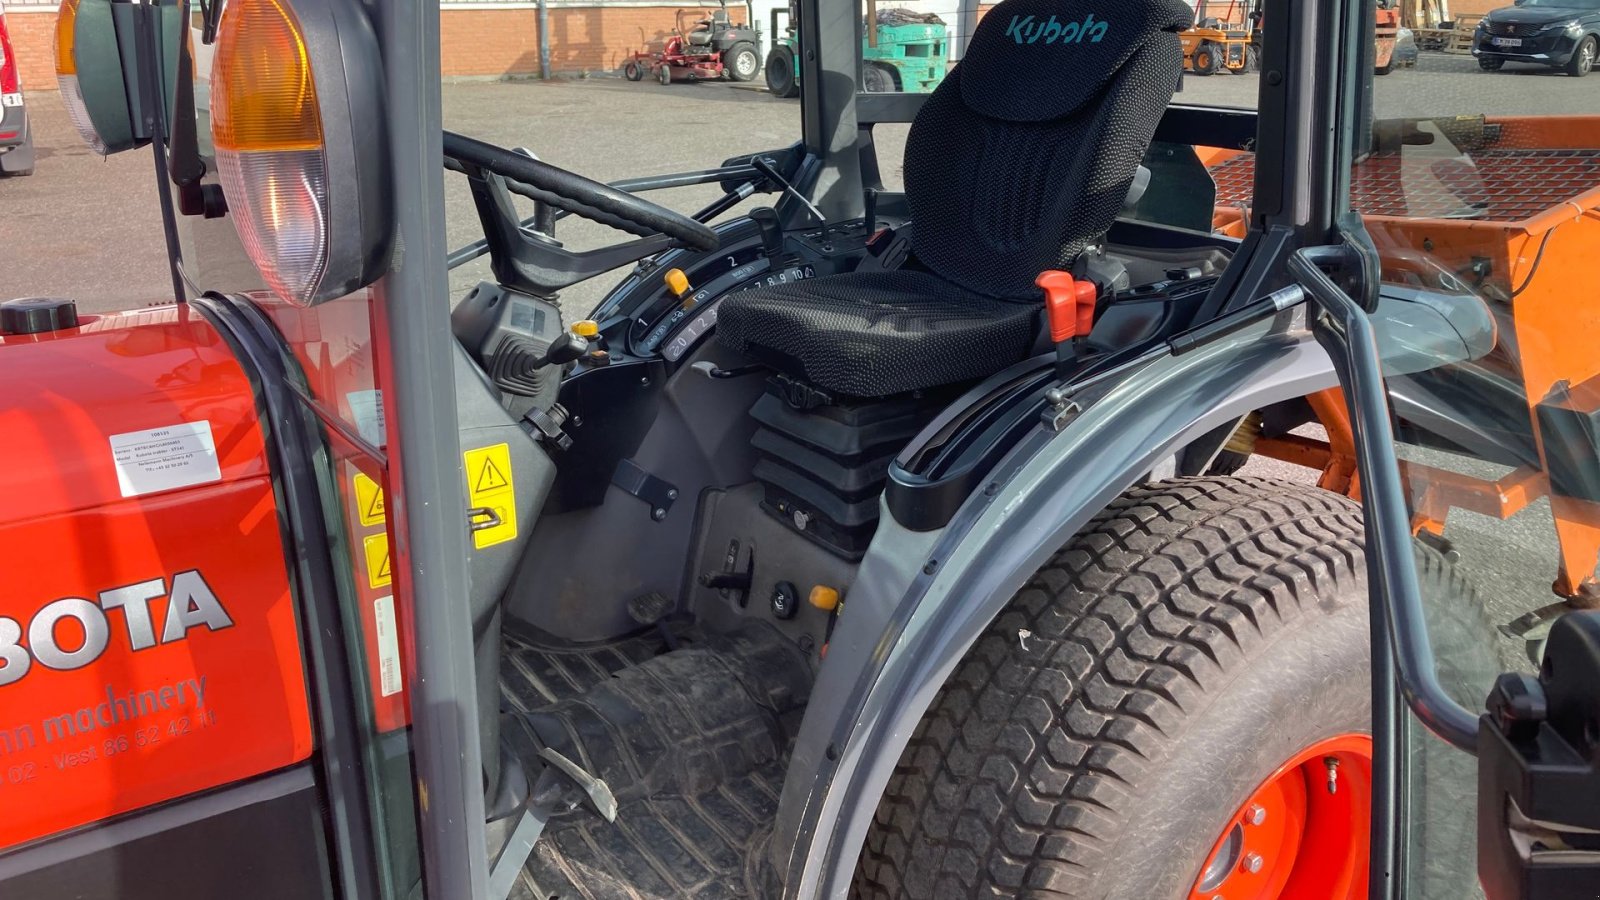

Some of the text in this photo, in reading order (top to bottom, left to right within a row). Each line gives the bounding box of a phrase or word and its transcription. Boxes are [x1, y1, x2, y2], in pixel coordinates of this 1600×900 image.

[1005, 13, 1109, 44] Kubota
[727, 256, 738, 267] 2
[766, 277, 776, 287] 8
[779, 273, 787, 284] 9
[792, 269, 804, 280] 10
[638, 317, 648, 327] 1
[688, 328, 697, 336] 1
[697, 317, 708, 328] 2
[43, 676, 207, 744] machinery
[8, 763, 37, 785] 02
[53, 745, 98, 771] Vest
[103, 734, 130, 758] 86
[135, 726, 162, 748] 52
[167, 716, 193, 737] 42
[199, 709, 217, 729] 11
